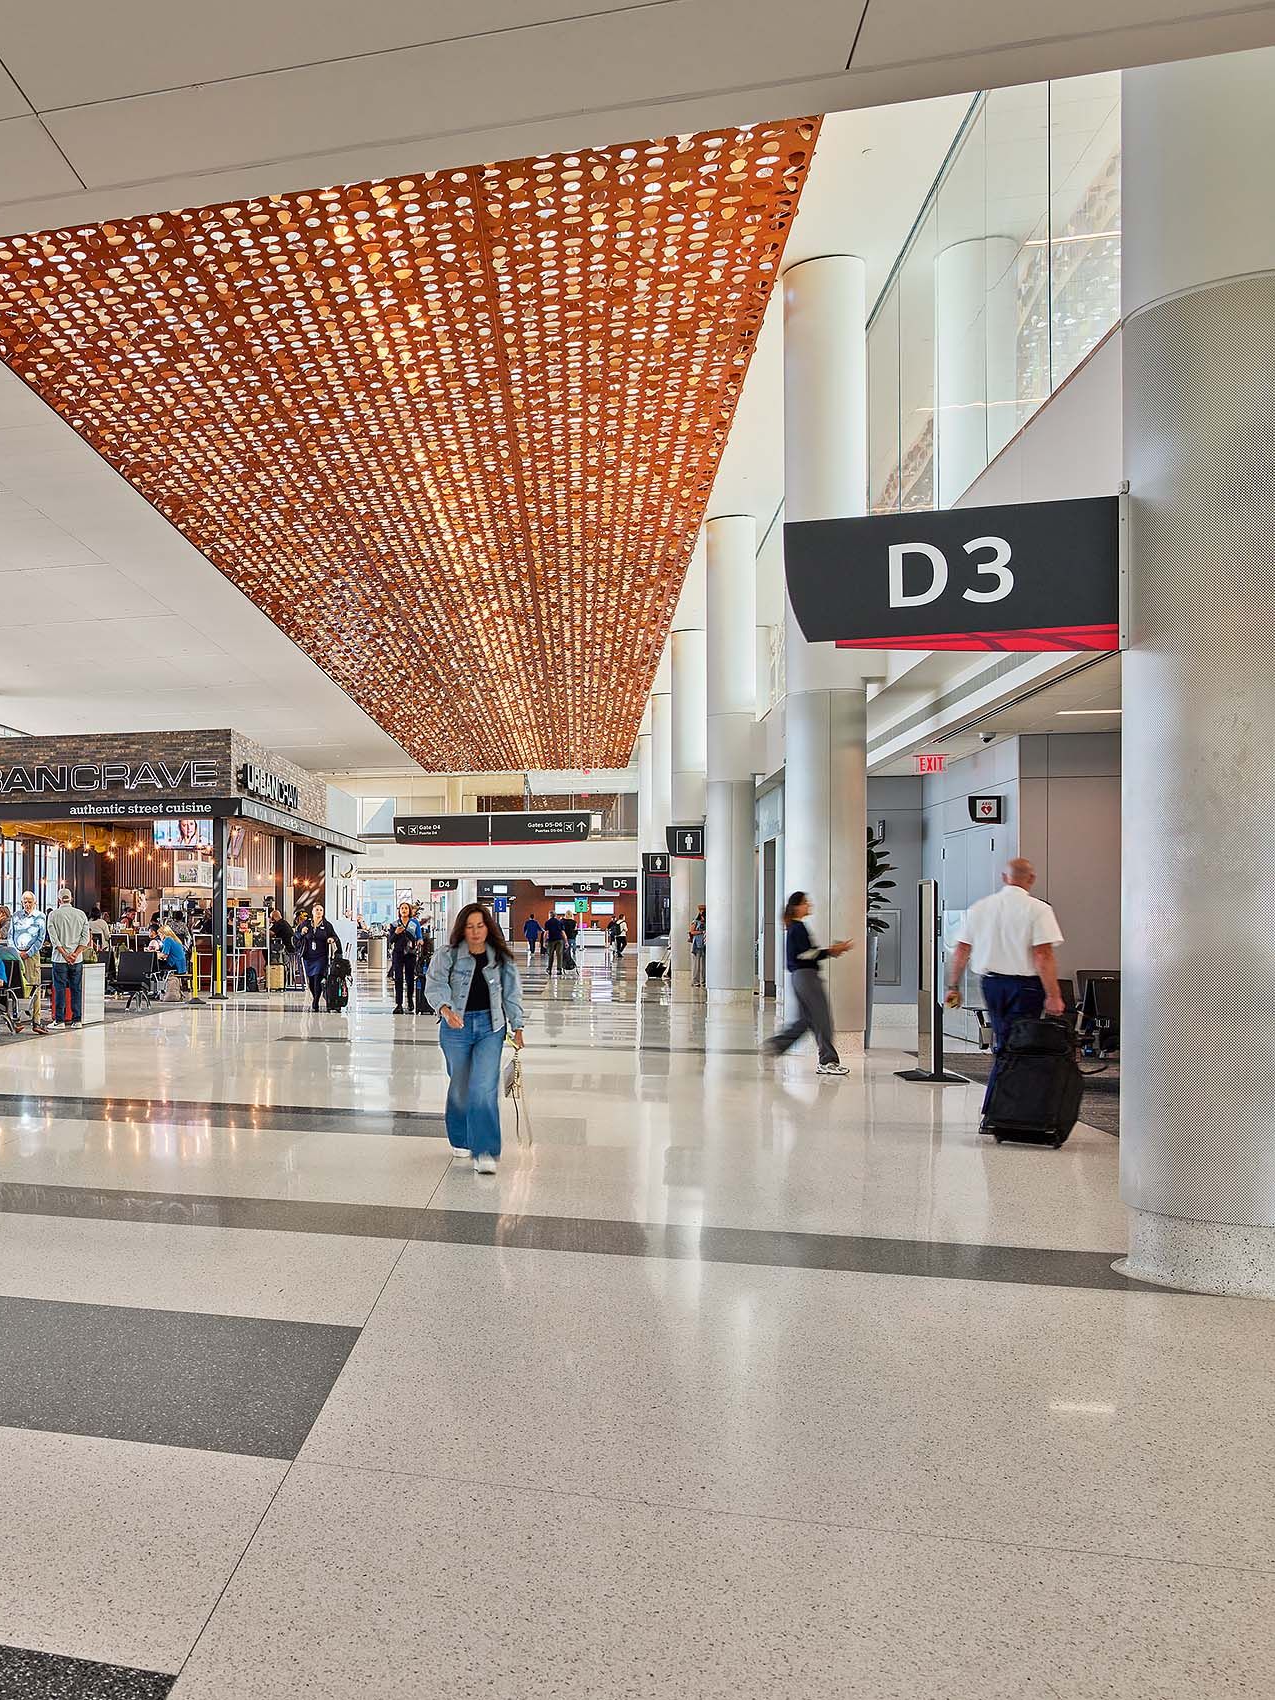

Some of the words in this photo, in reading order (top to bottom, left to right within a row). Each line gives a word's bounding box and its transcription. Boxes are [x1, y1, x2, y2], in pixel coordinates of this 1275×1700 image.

[888, 536, 1015, 609] D3
[918, 756, 945, 772] EXIT
[69, 803, 126, 816] authentic
[127, 802, 164, 815] street
[165, 801, 212, 814] cuisine
[438, 880, 451, 888] D4
[580, 884, 592, 892] D6
[612, 879, 628, 889] D5
